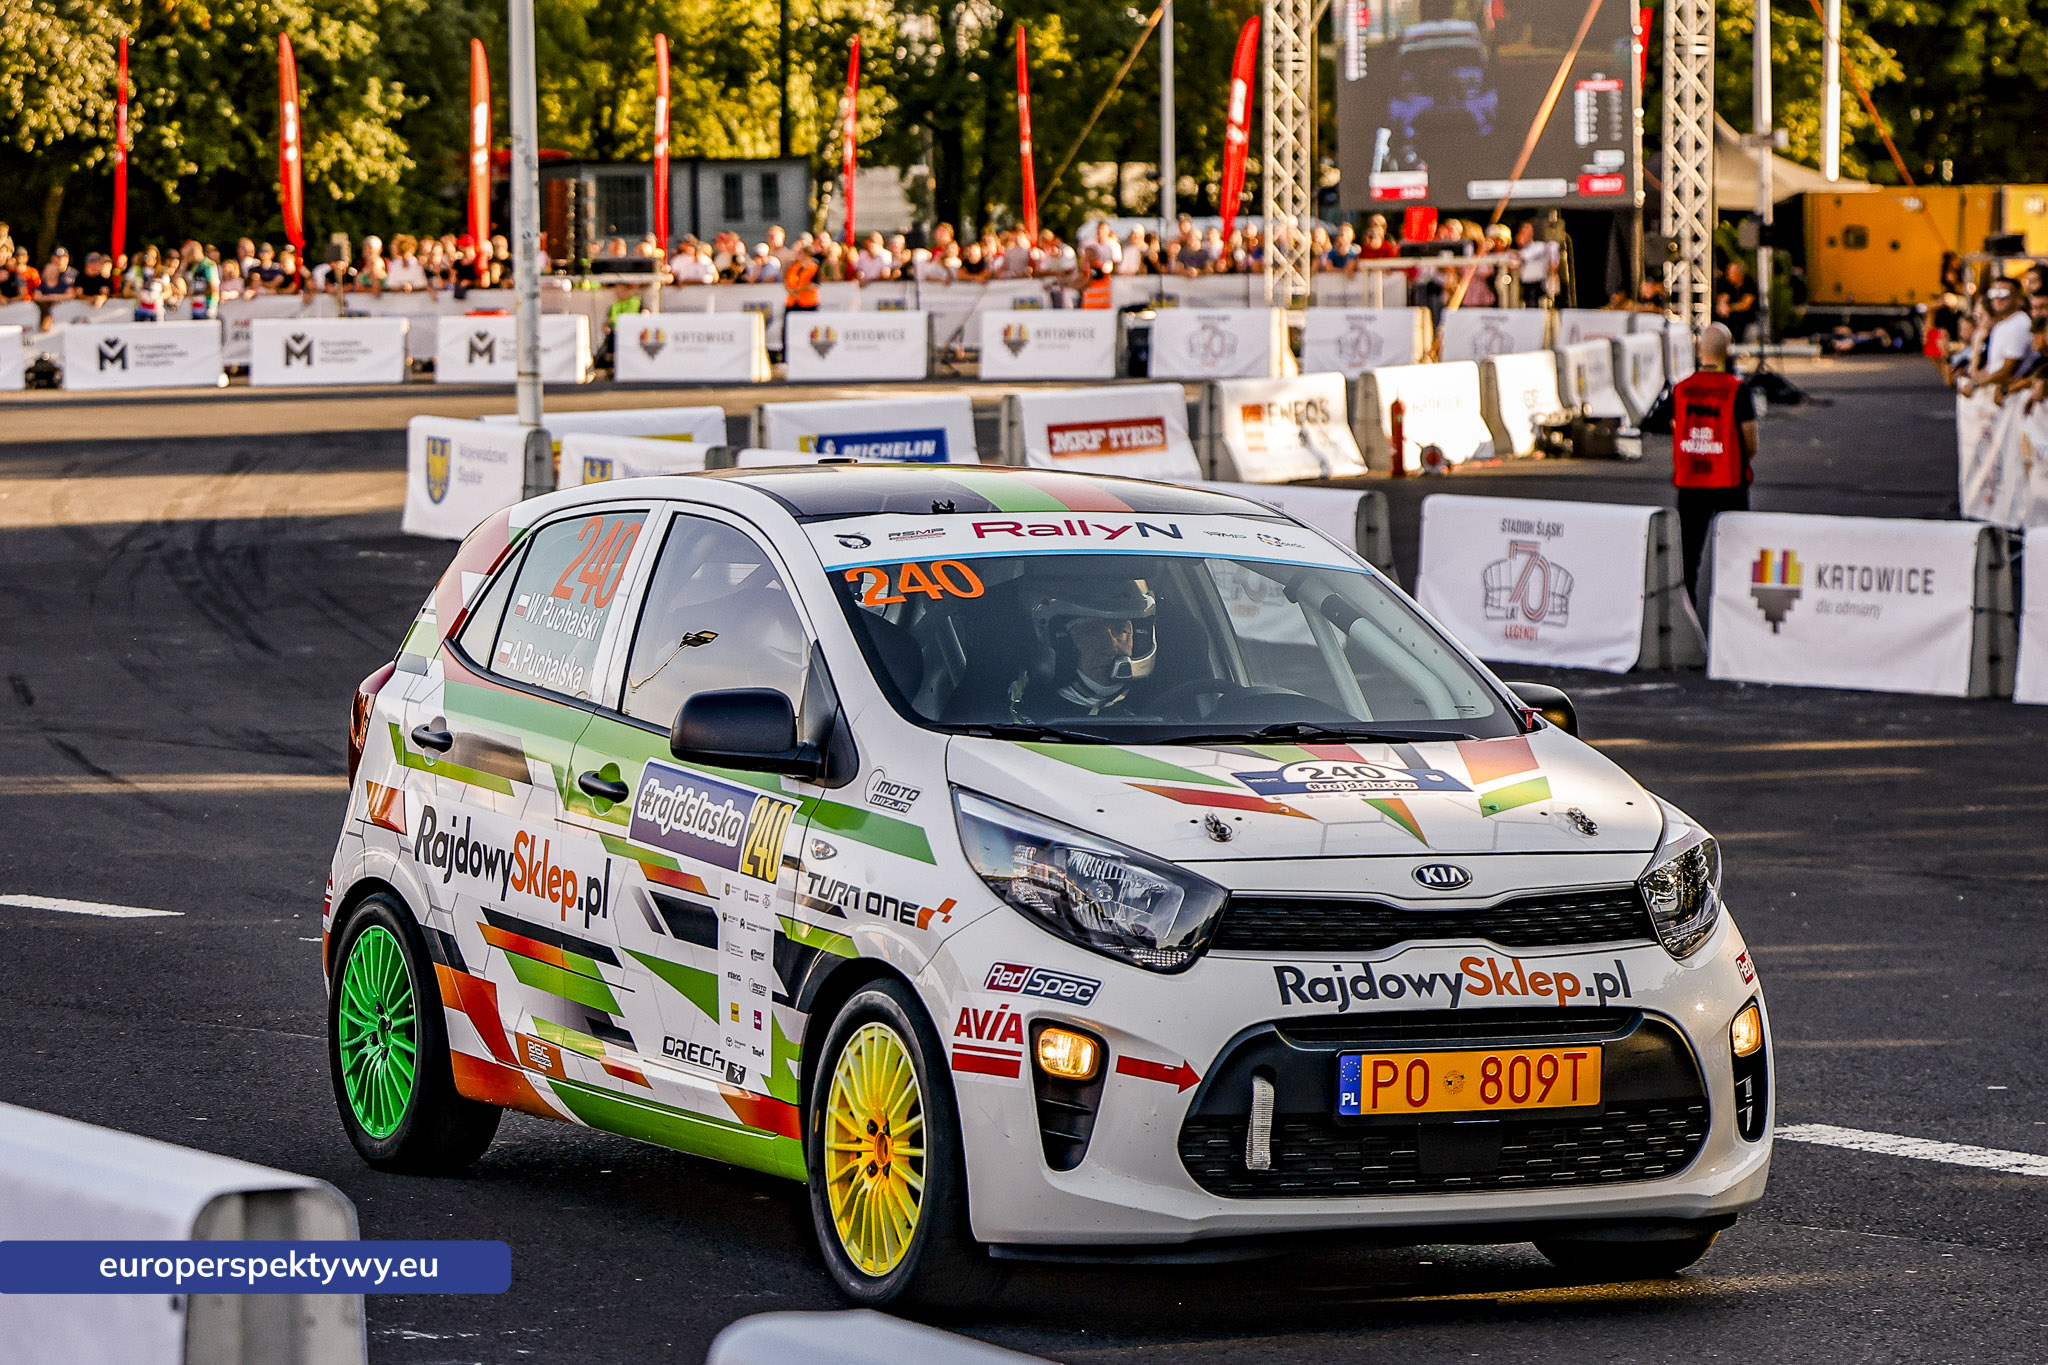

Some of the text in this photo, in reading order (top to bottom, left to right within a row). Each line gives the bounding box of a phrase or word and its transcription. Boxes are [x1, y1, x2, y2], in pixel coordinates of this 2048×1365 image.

[842, 439, 937, 459] MICHELIN
[1051, 424, 1164, 454] MRF TYRES
[888, 527, 945, 539] RSMP
[971, 519, 1185, 541] RallyN
[1501, 518, 1535, 535] STADION
[551, 514, 643, 610] 240
[844, 559, 986, 607] 240
[1816, 563, 1935, 596] KATOWICE
[1297, 766, 1388, 781] 240
[1308, 781, 1418, 792] #rajdslaska
[876, 780, 921, 801] MOTO
[639, 779, 744, 843] #rajdslaska
[740, 796, 794, 884] 240
[414, 804, 612, 930] RajdowySklep.pl
[1421, 866, 1465, 884] KIA
[807, 871, 920, 927] TURN ONE
[1272, 955, 1633, 1013] RajdowySklep.pl
[1371, 1051, 1589, 1110] PO 809T
[1341, 1092, 1359, 1106] PL
